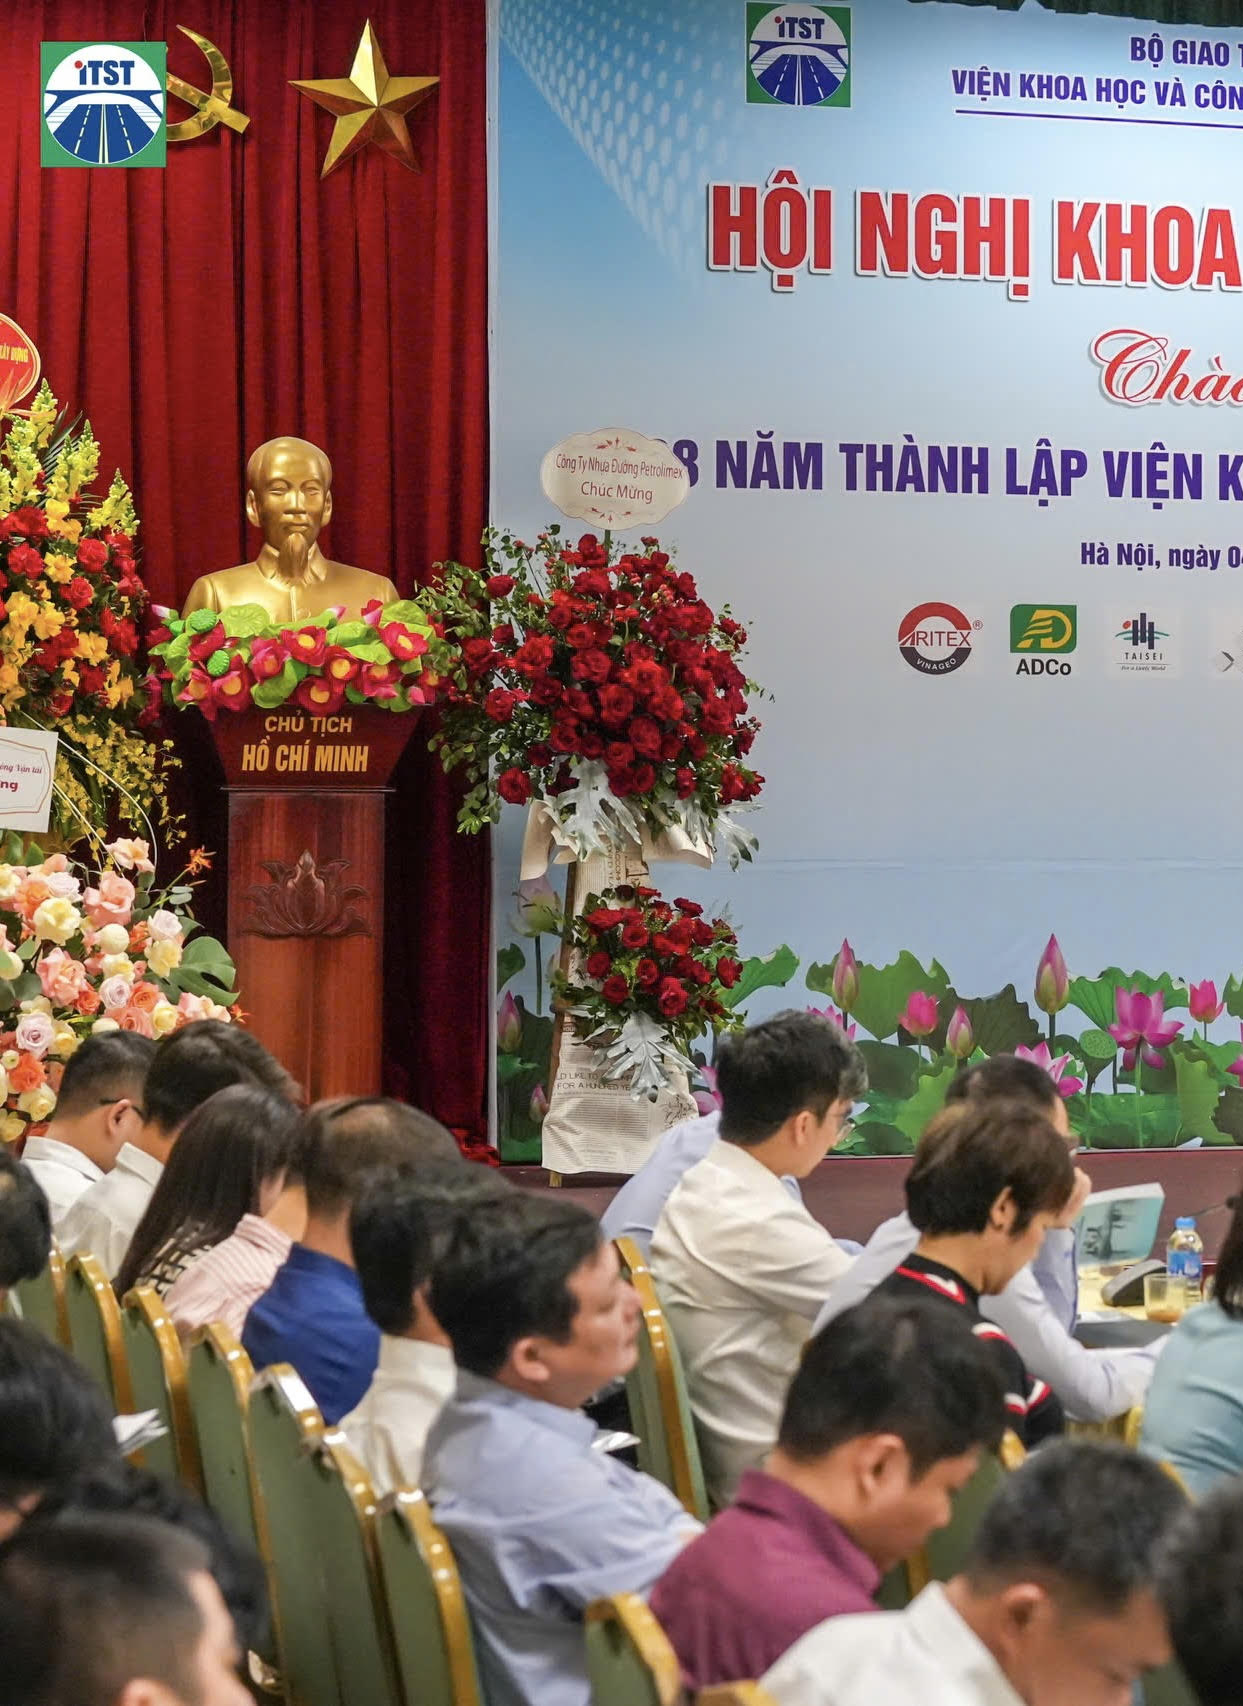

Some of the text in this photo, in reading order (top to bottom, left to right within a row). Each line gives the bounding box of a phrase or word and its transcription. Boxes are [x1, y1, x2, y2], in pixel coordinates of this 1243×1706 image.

[774, 16, 825, 39] iTST
[1131, 33, 1164, 68] BỘ
[1173, 40, 1230, 67] GIAO
[952, 66, 1012, 101] VIỆN
[1020, 74, 1089, 101] KHOA
[1096, 78, 1147, 109] HỌC
[1155, 77, 1188, 107] VÀ
[711, 168, 833, 289] HỘI
[860, 190, 1031, 299] NGHỊ
[1057, 200, 1243, 290] KHOA
[555, 453, 578, 474] Công
[578, 456, 588, 474] Ty
[611, 458, 639, 479] Đường
[640, 461, 684, 480] Petrolimex
[715, 430, 824, 492] NĂM
[838, 433, 990, 496] THÀNH
[1006, 438, 1089, 507] LẬP
[1103, 441, 1204, 511] VIỆN
[580, 481, 654, 505] Chúc Mừng
[1080, 542, 1110, 566] Hà
[1116, 543, 1161, 571] Nội,
[1168, 545, 1221, 571] ngày
[899, 630, 972, 648] ARITEX
[915, 657, 958, 671] VINAGEO
[1015, 658, 1072, 676] ADCo
[1125, 652, 1163, 660] TAISEI
[264, 710, 353, 738] CHỦ TỊCH
[241, 735, 369, 772] HỒ CHÍ MINH
[0, 780, 19, 793] ng
